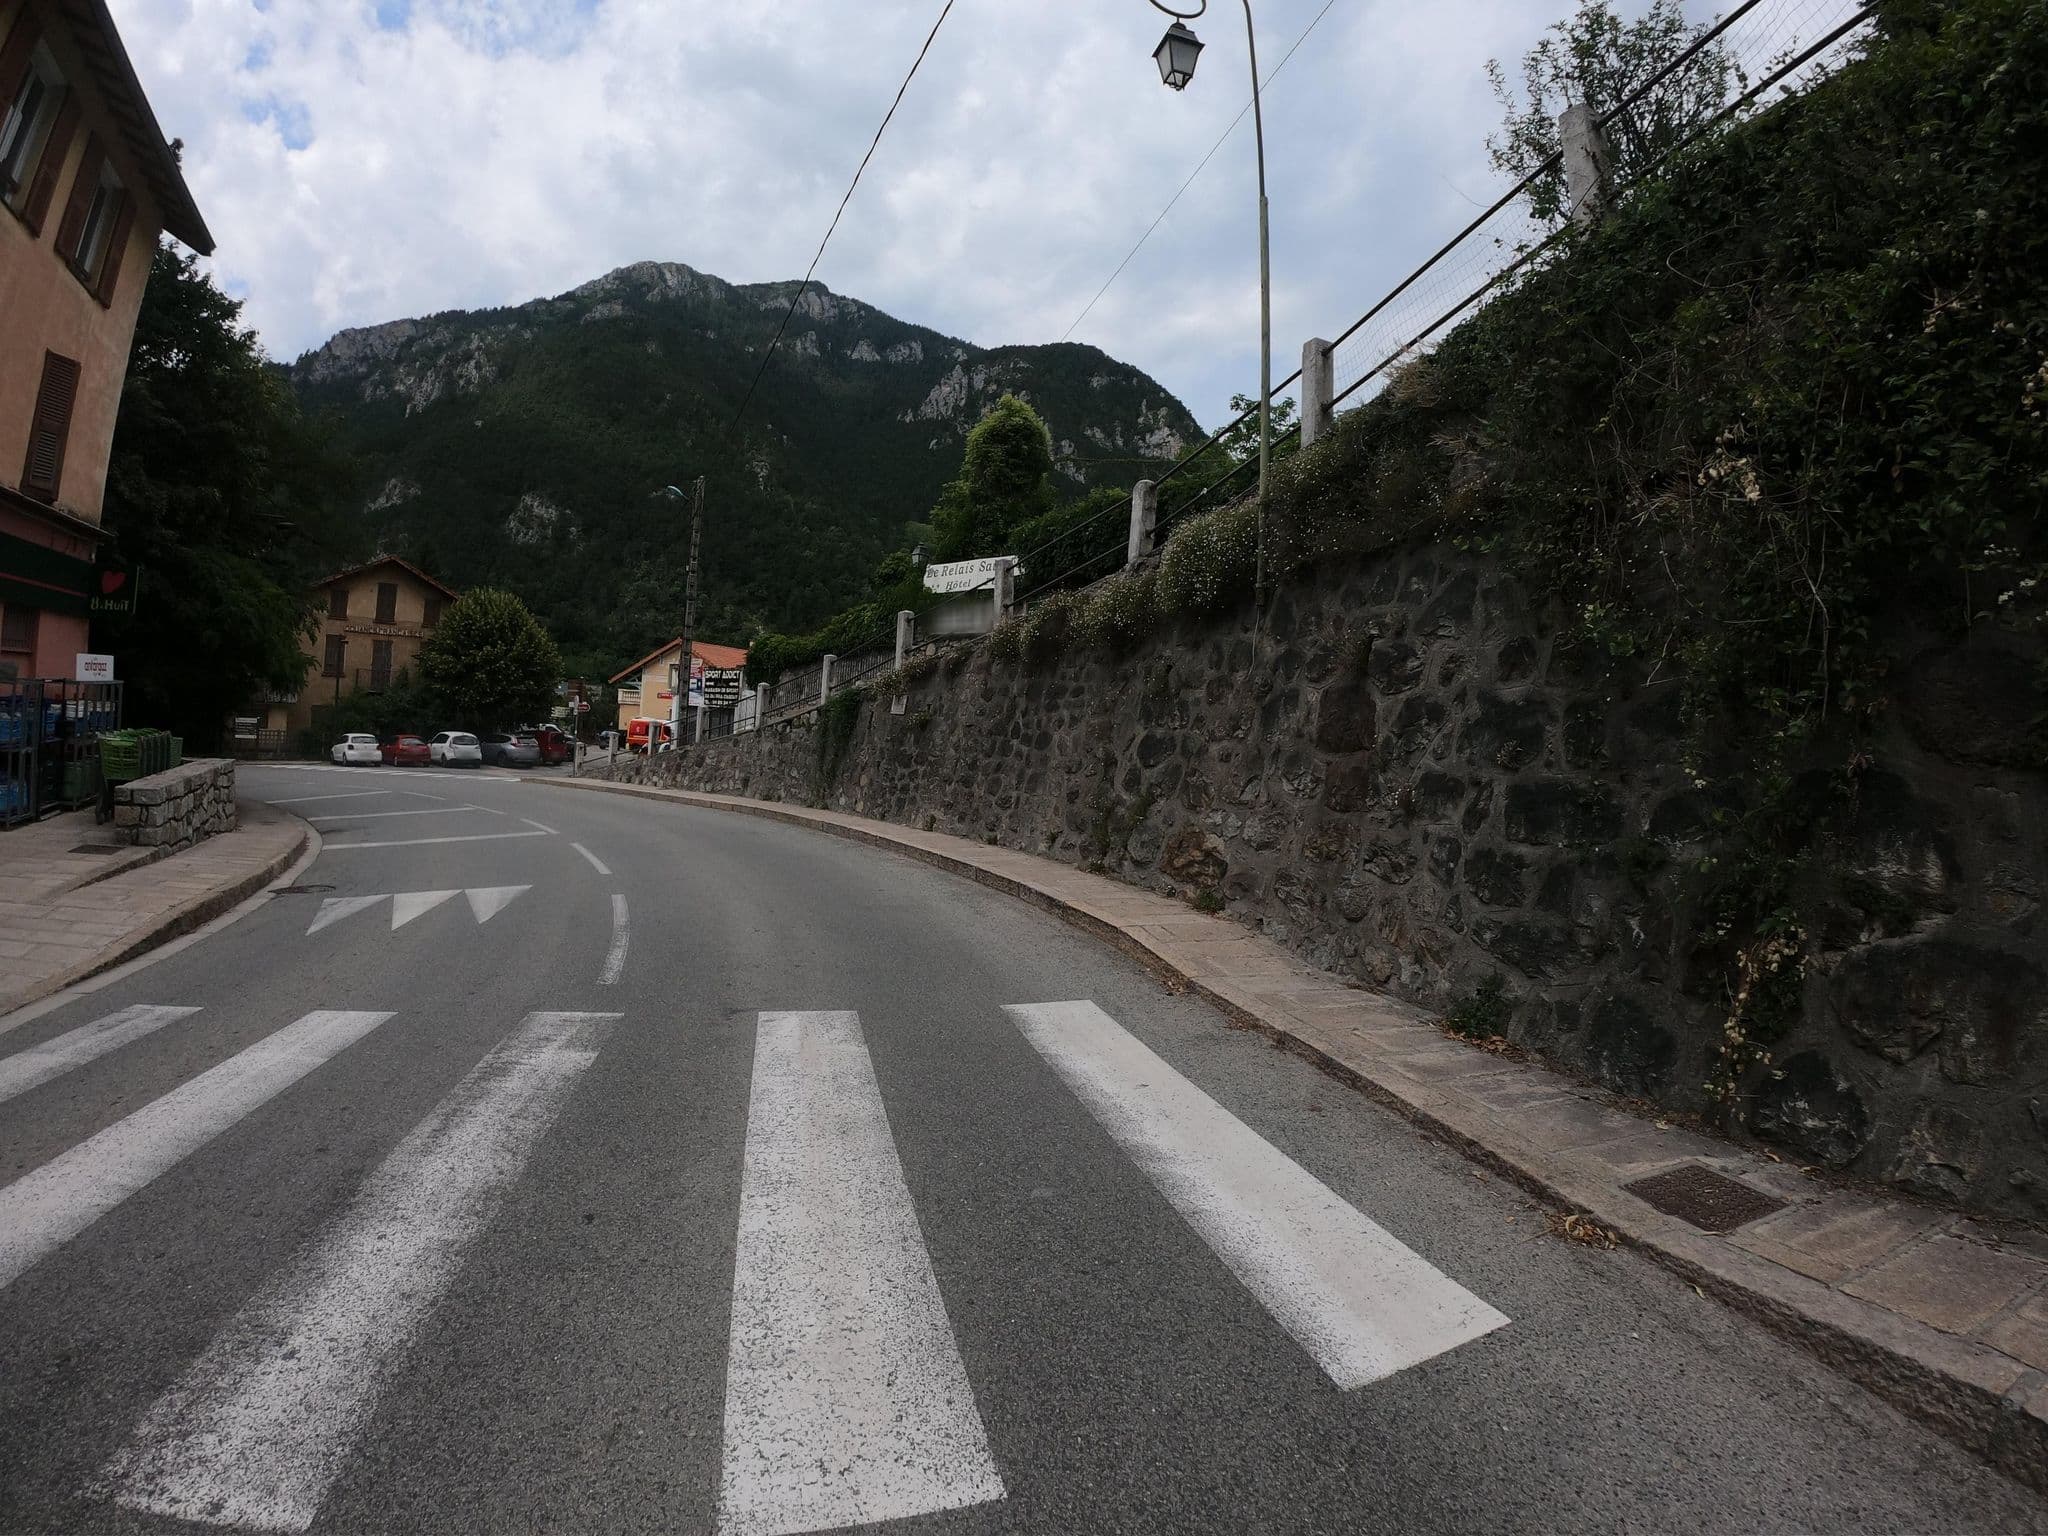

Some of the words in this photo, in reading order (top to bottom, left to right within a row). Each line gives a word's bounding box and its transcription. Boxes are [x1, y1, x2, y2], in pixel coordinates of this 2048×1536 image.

[927, 567, 939, 579] Le
[941, 562, 974, 577] Relais
[705, 670, 721, 679] SPORT
[722, 670, 740, 679] ADDICT
